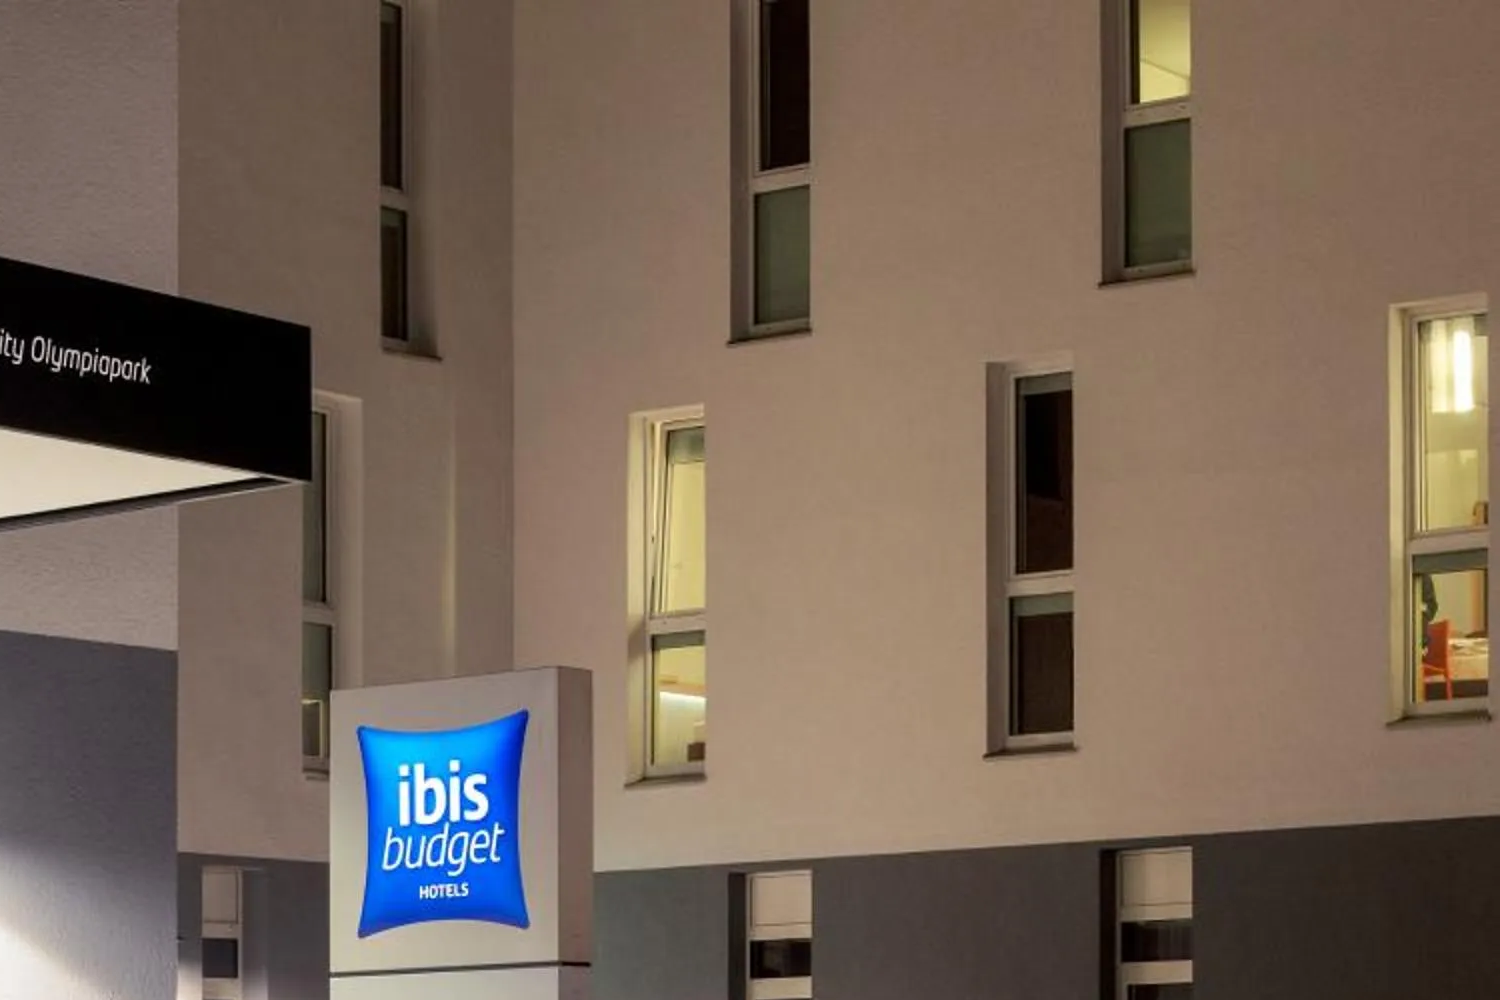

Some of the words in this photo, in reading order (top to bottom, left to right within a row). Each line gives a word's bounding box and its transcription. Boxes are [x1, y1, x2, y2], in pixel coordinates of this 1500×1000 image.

[31, 335, 152, 384] Olympiapark
[397, 759, 489, 827] ibis
[381, 822, 505, 876] budget
[419, 882, 469, 900] HOTELS
